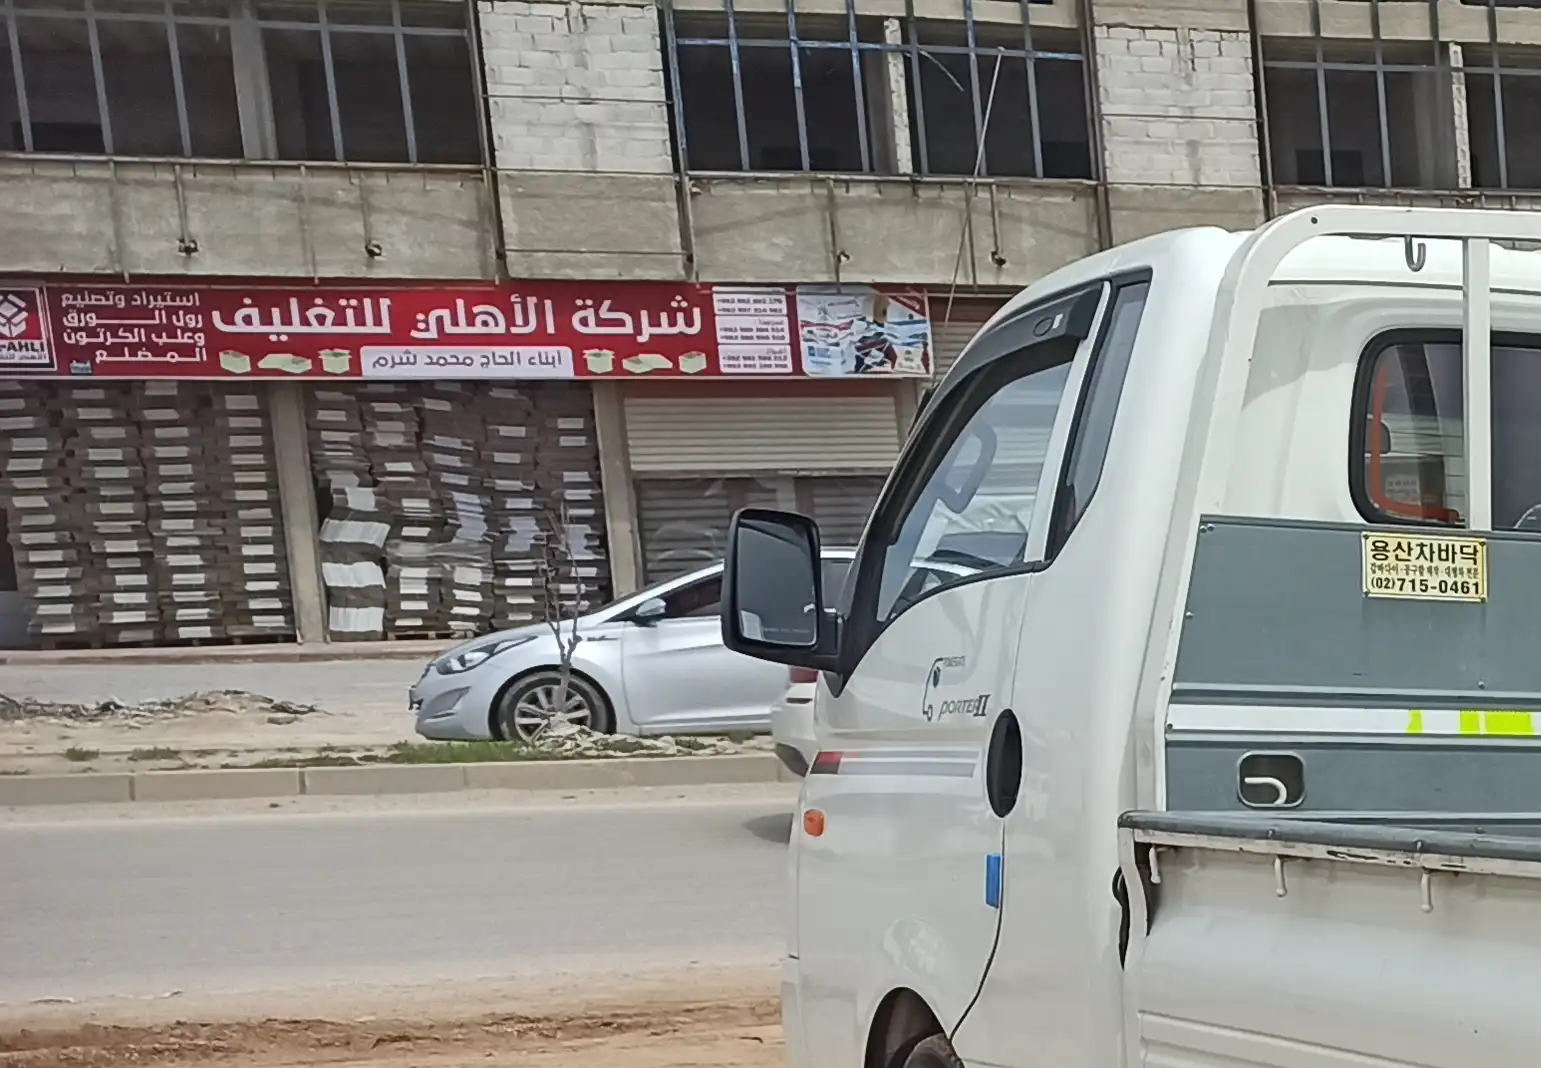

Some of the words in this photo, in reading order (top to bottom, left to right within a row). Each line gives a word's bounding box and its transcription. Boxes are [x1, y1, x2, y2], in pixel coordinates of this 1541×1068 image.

[172, 311, 203, 328] رول
[212, 297, 392, 342] للتغليف
[410, 293, 556, 339] الأهلي
[571, 295, 702, 343] شركة
[63, 328, 146, 346] الكرتون
[151, 329, 206, 347] وعلب
[95, 348, 207, 363] المضلع
[424, 355, 474, 367] محمد
[480, 352, 521, 368] الحاج
[1370, 540, 1479, 565] 용산차바닥
[1371, 577, 1479, 595] (02)715-0461
